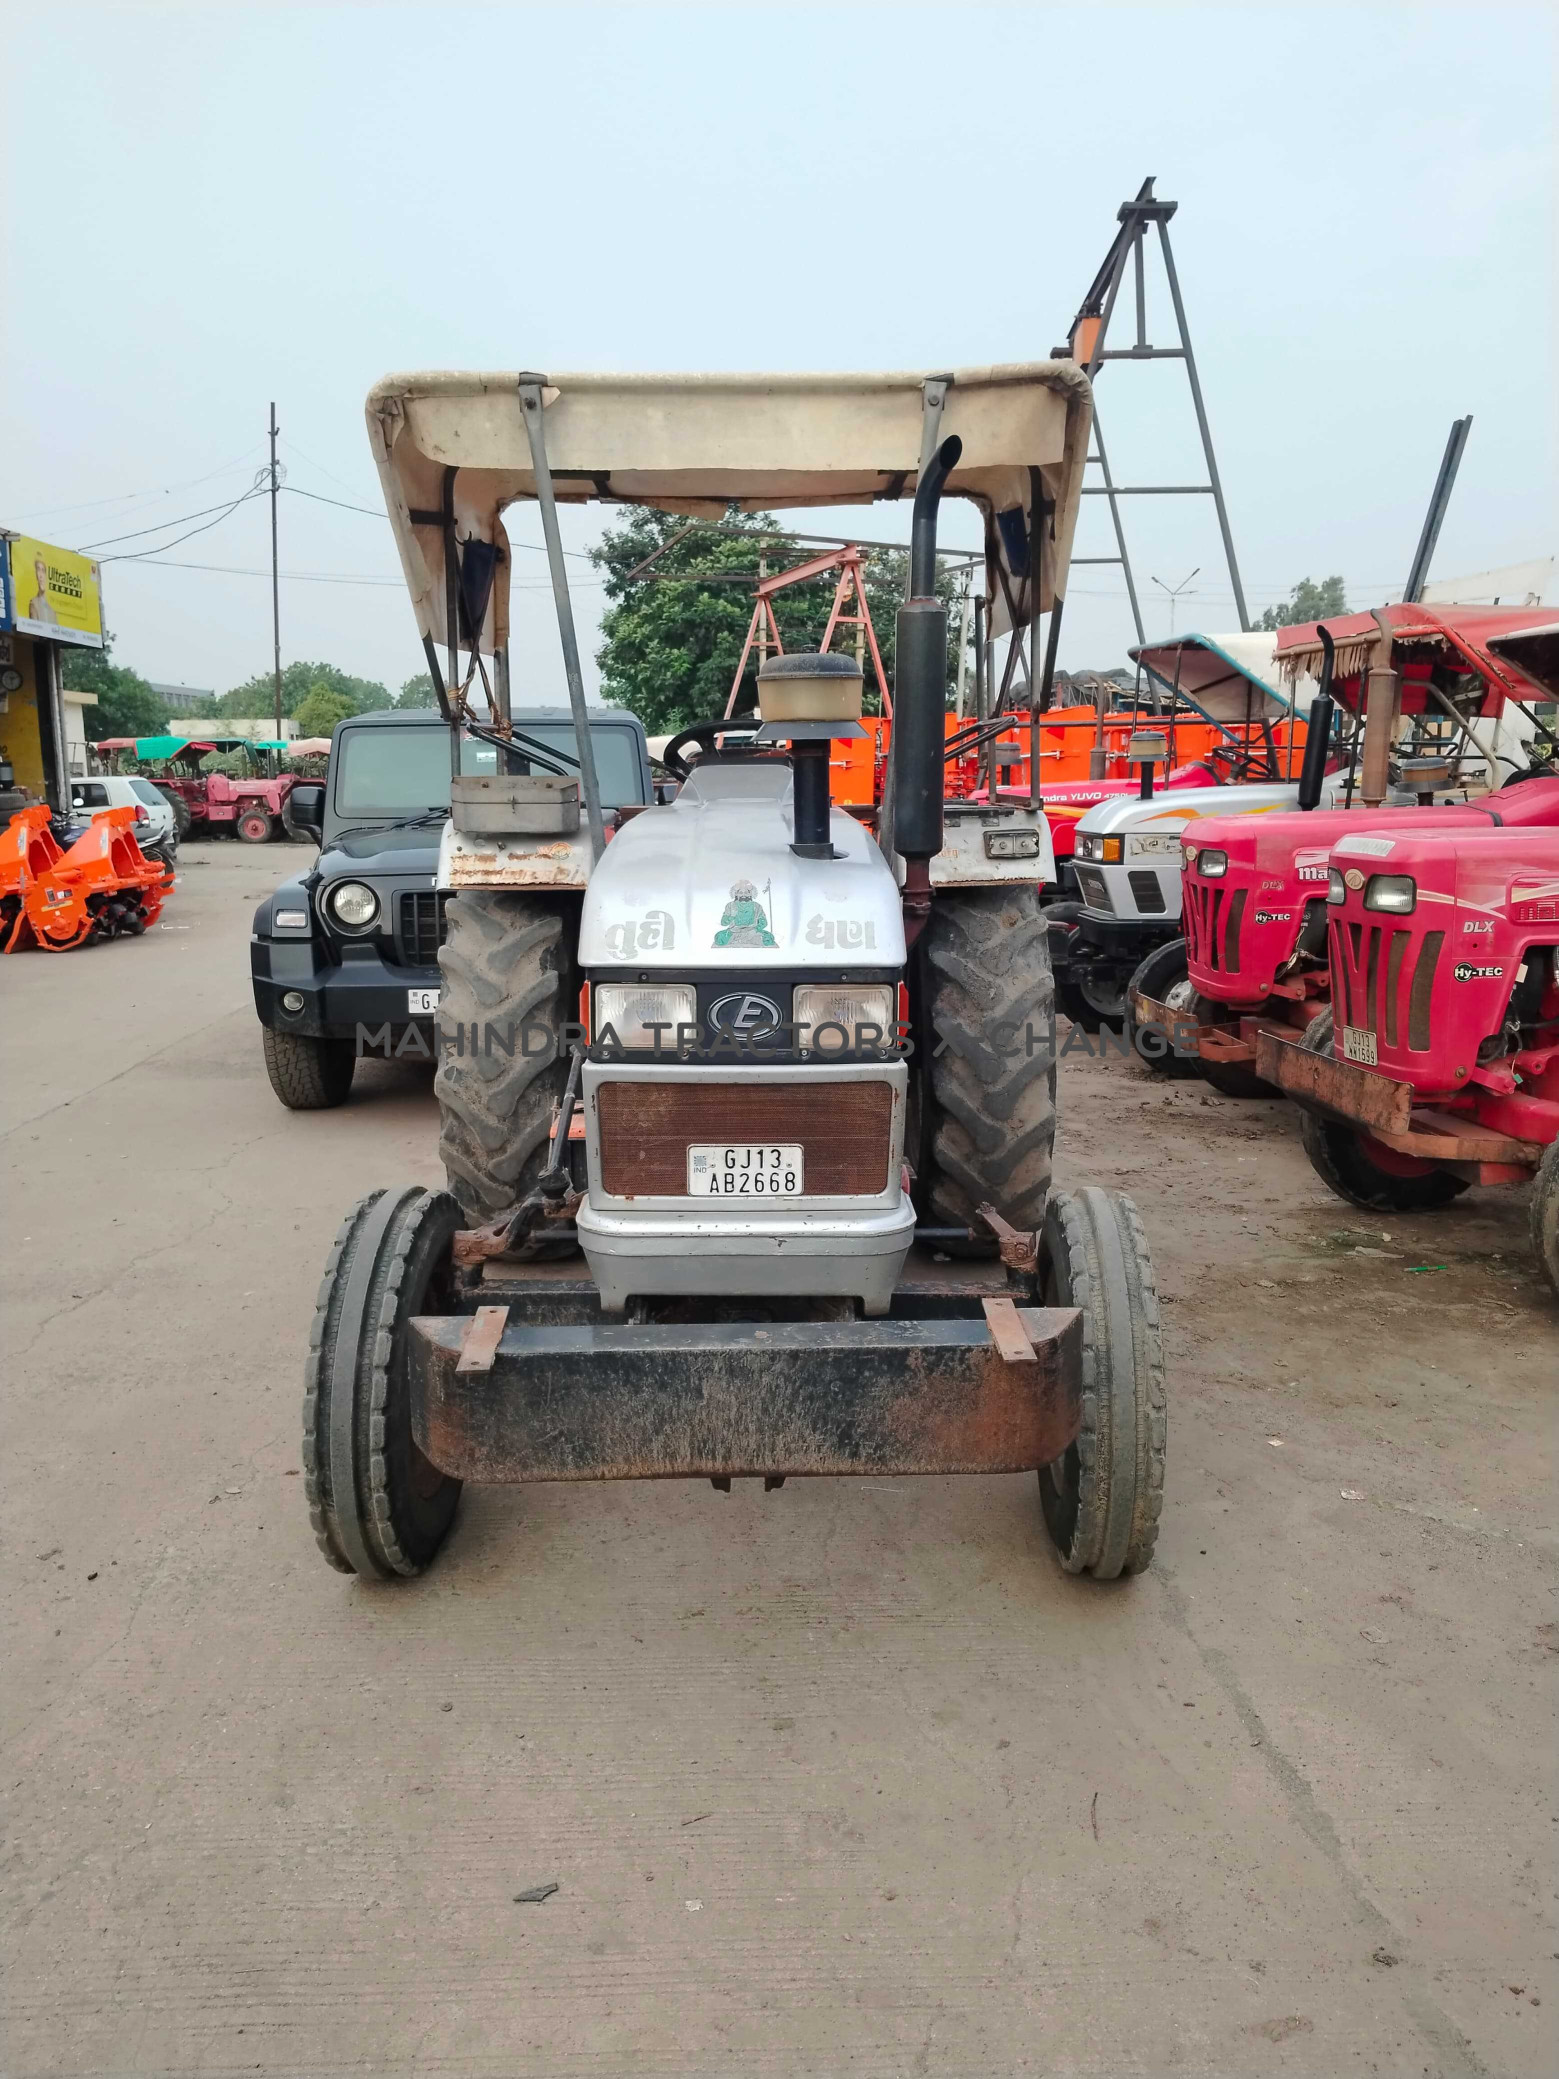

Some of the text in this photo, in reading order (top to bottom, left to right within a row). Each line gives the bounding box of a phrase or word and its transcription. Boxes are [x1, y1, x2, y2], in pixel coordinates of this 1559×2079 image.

[48, 566, 82, 589] UltraTech
[1071, 792, 1102, 800] YUVO
[1255, 912, 1291, 923] Hy-TEC
[1463, 921, 1495, 933] DLX
[1454, 966, 1504, 979] Hy-TEC
[724, 1148, 782, 1169] GJ13
[709, 1171, 796, 1193] AB2668
